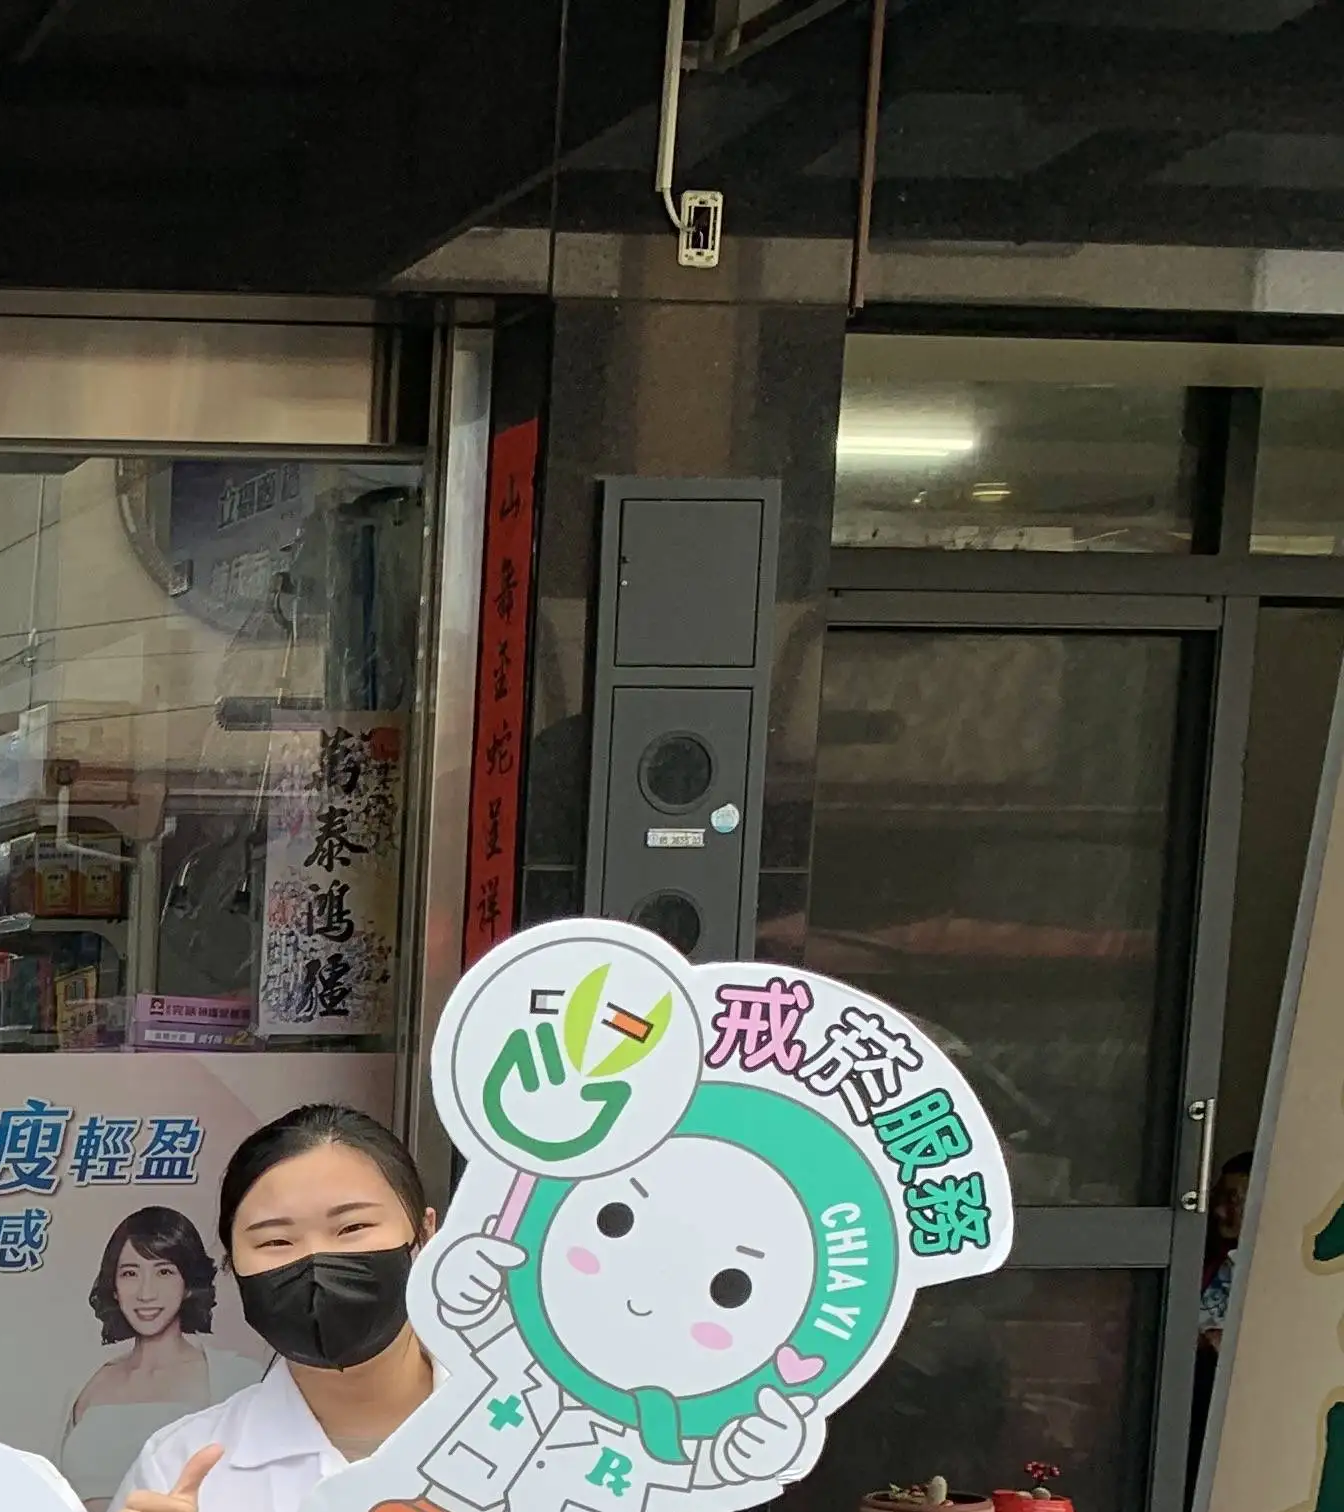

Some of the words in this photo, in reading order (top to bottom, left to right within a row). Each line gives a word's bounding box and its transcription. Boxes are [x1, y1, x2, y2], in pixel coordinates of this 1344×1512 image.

[710, 977, 993, 1258] 戒菸服務
[819, 1201, 869, 1291] CHIA
